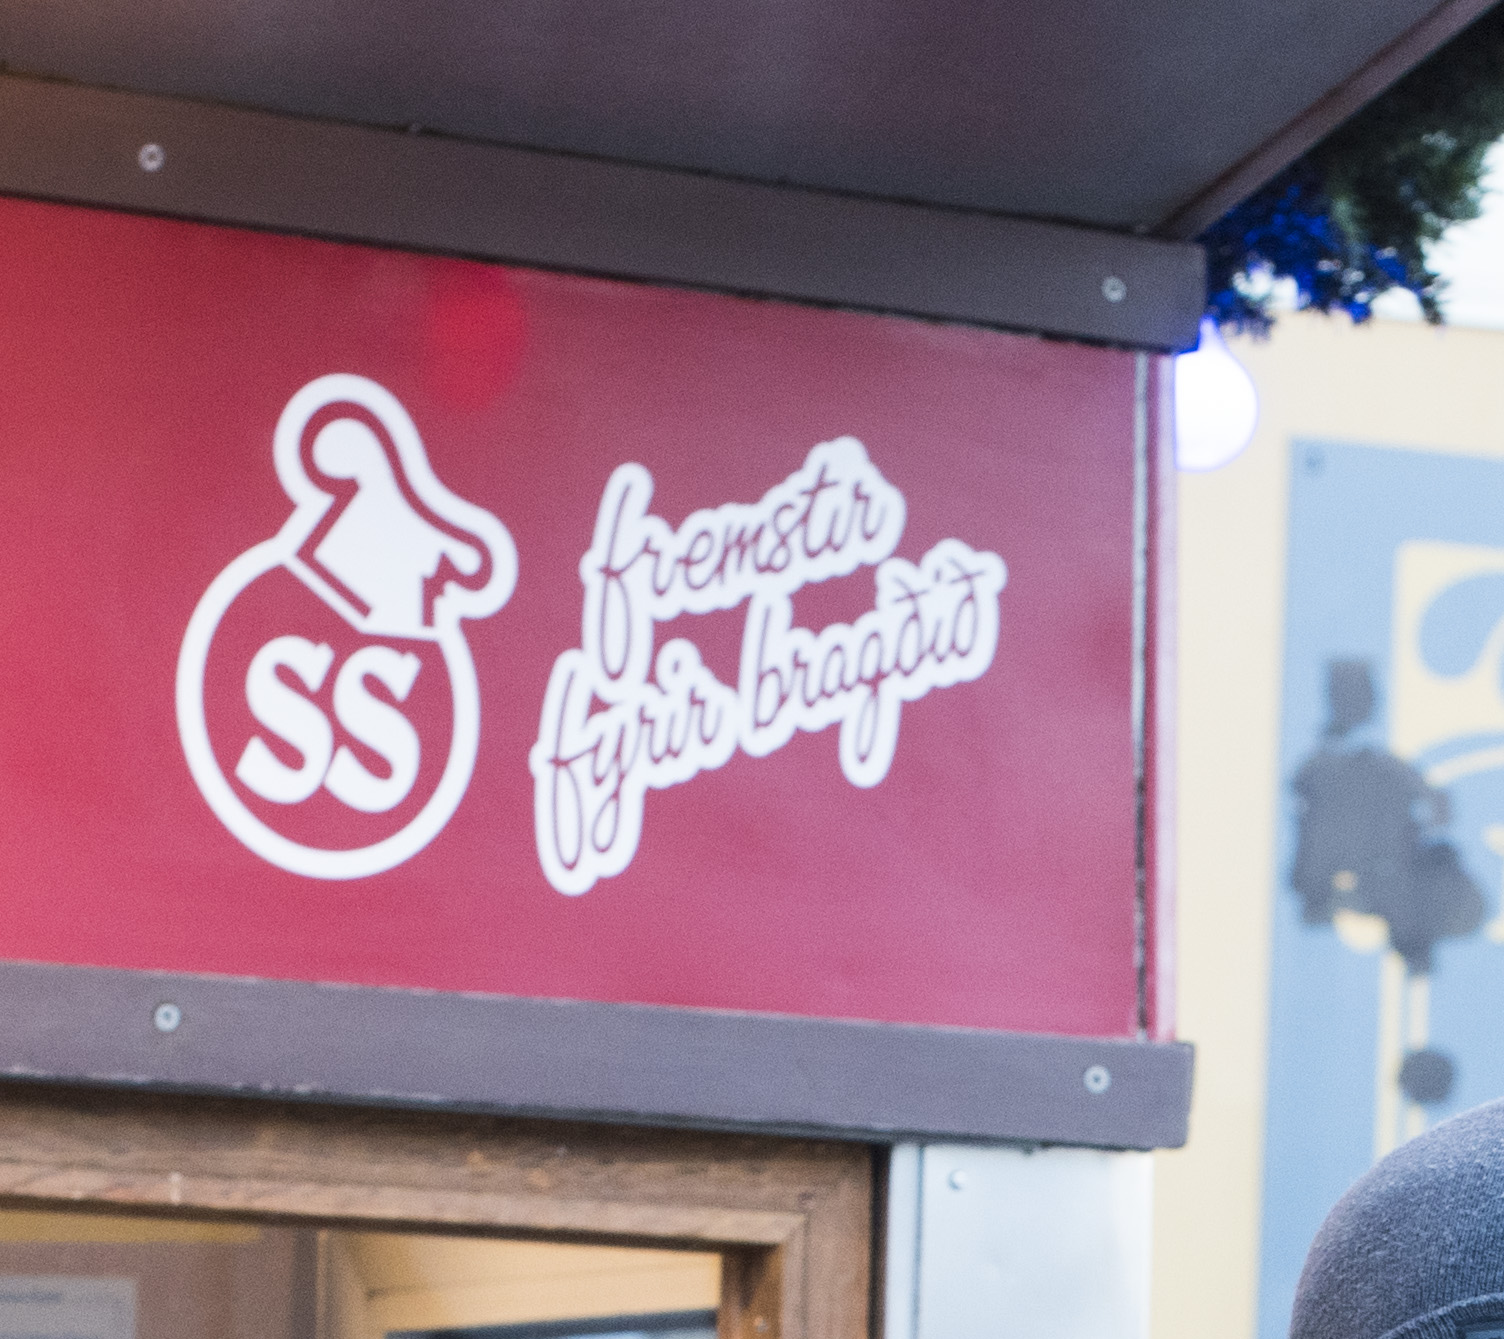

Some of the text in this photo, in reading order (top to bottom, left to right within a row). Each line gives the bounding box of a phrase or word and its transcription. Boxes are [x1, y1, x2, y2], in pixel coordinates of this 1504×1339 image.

[235, 634, 422, 813] SS
[542, 564, 989, 878] fyrir bragðið
